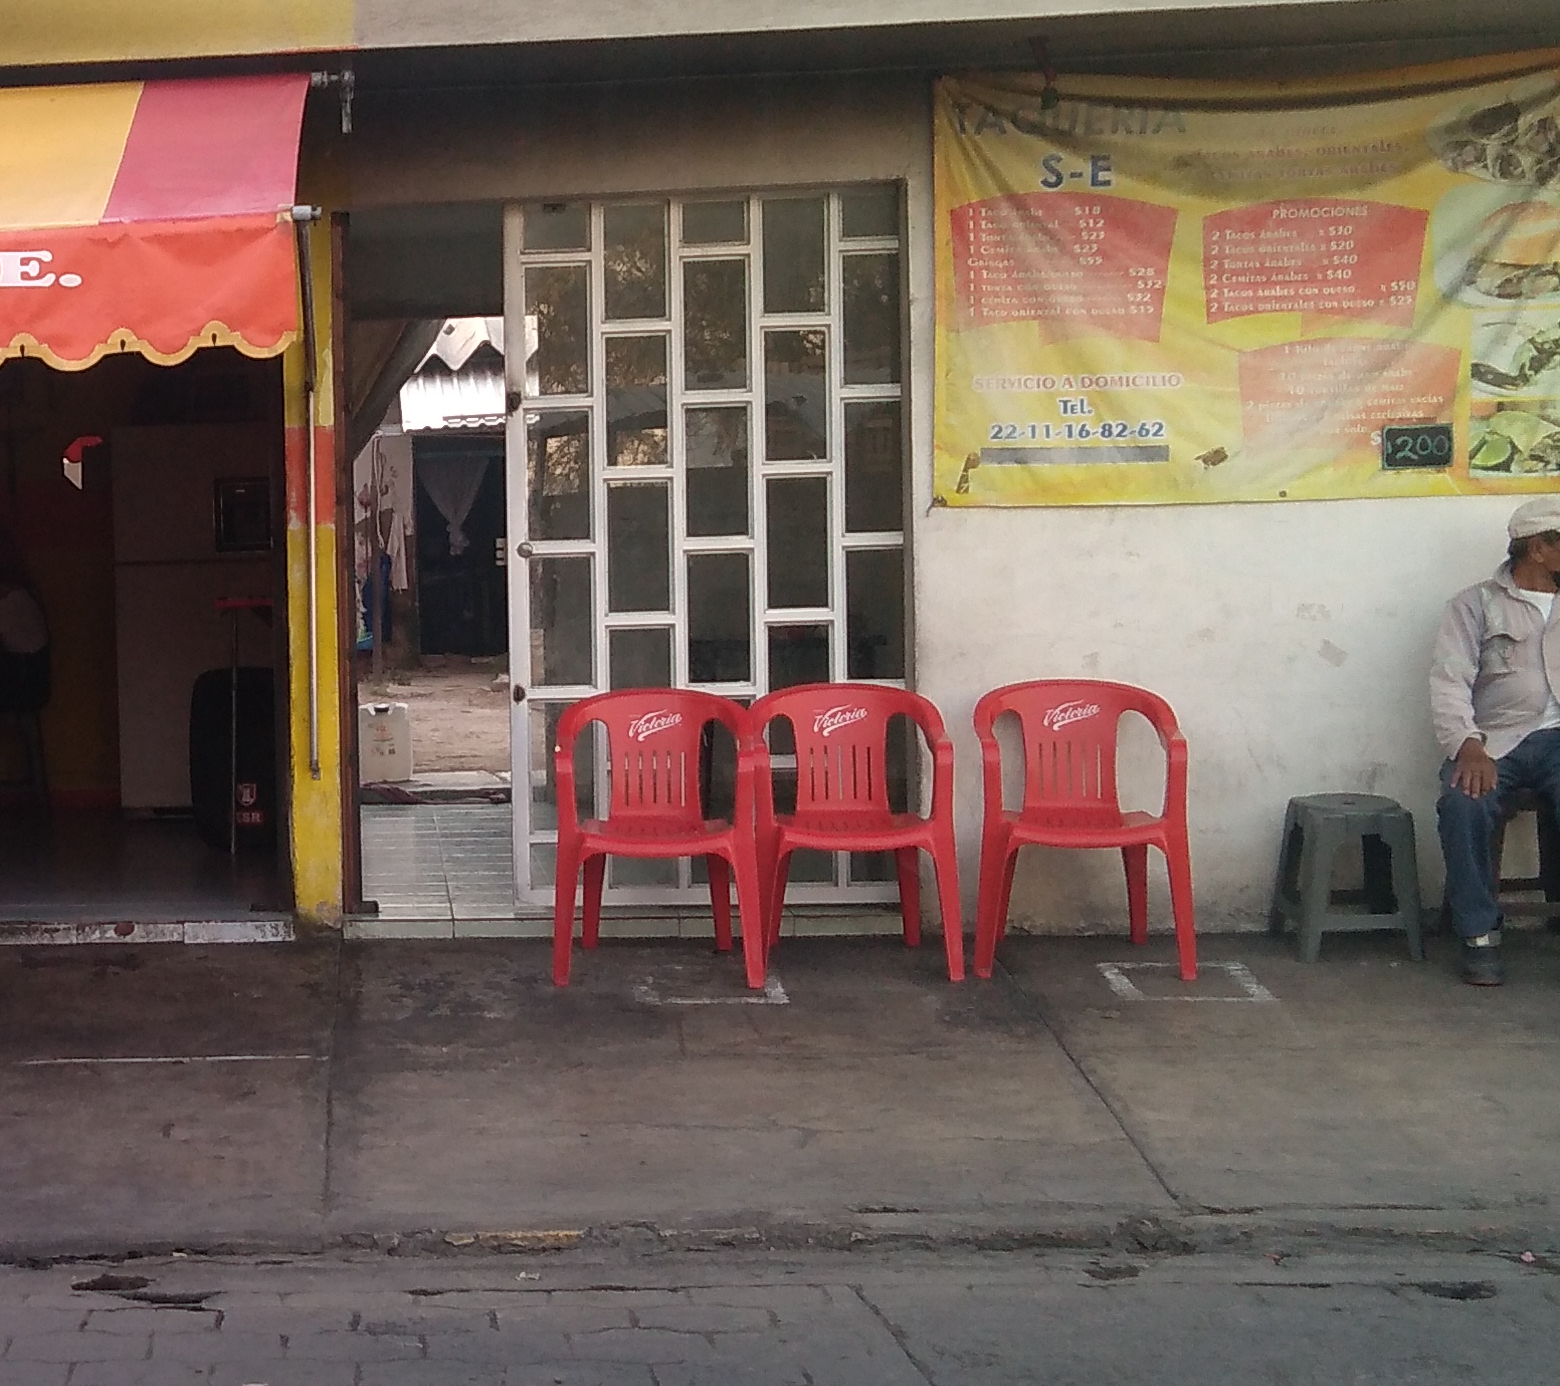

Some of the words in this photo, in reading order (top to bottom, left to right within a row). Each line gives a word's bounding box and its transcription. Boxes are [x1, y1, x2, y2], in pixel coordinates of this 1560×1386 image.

[1040, 154, 1113, 189] S-E
[1272, 205, 1369, 219] PROMOCIONES
[1062, 376, 1075, 389] A
[1080, 373, 1182, 389] DOMICILIO
[989, 421, 1166, 441] 22-11-16-82-62
[628, 709, 683, 742] Victoria
[813, 703, 868, 737] Victoria
[1043, 699, 1101, 731] Victoria
